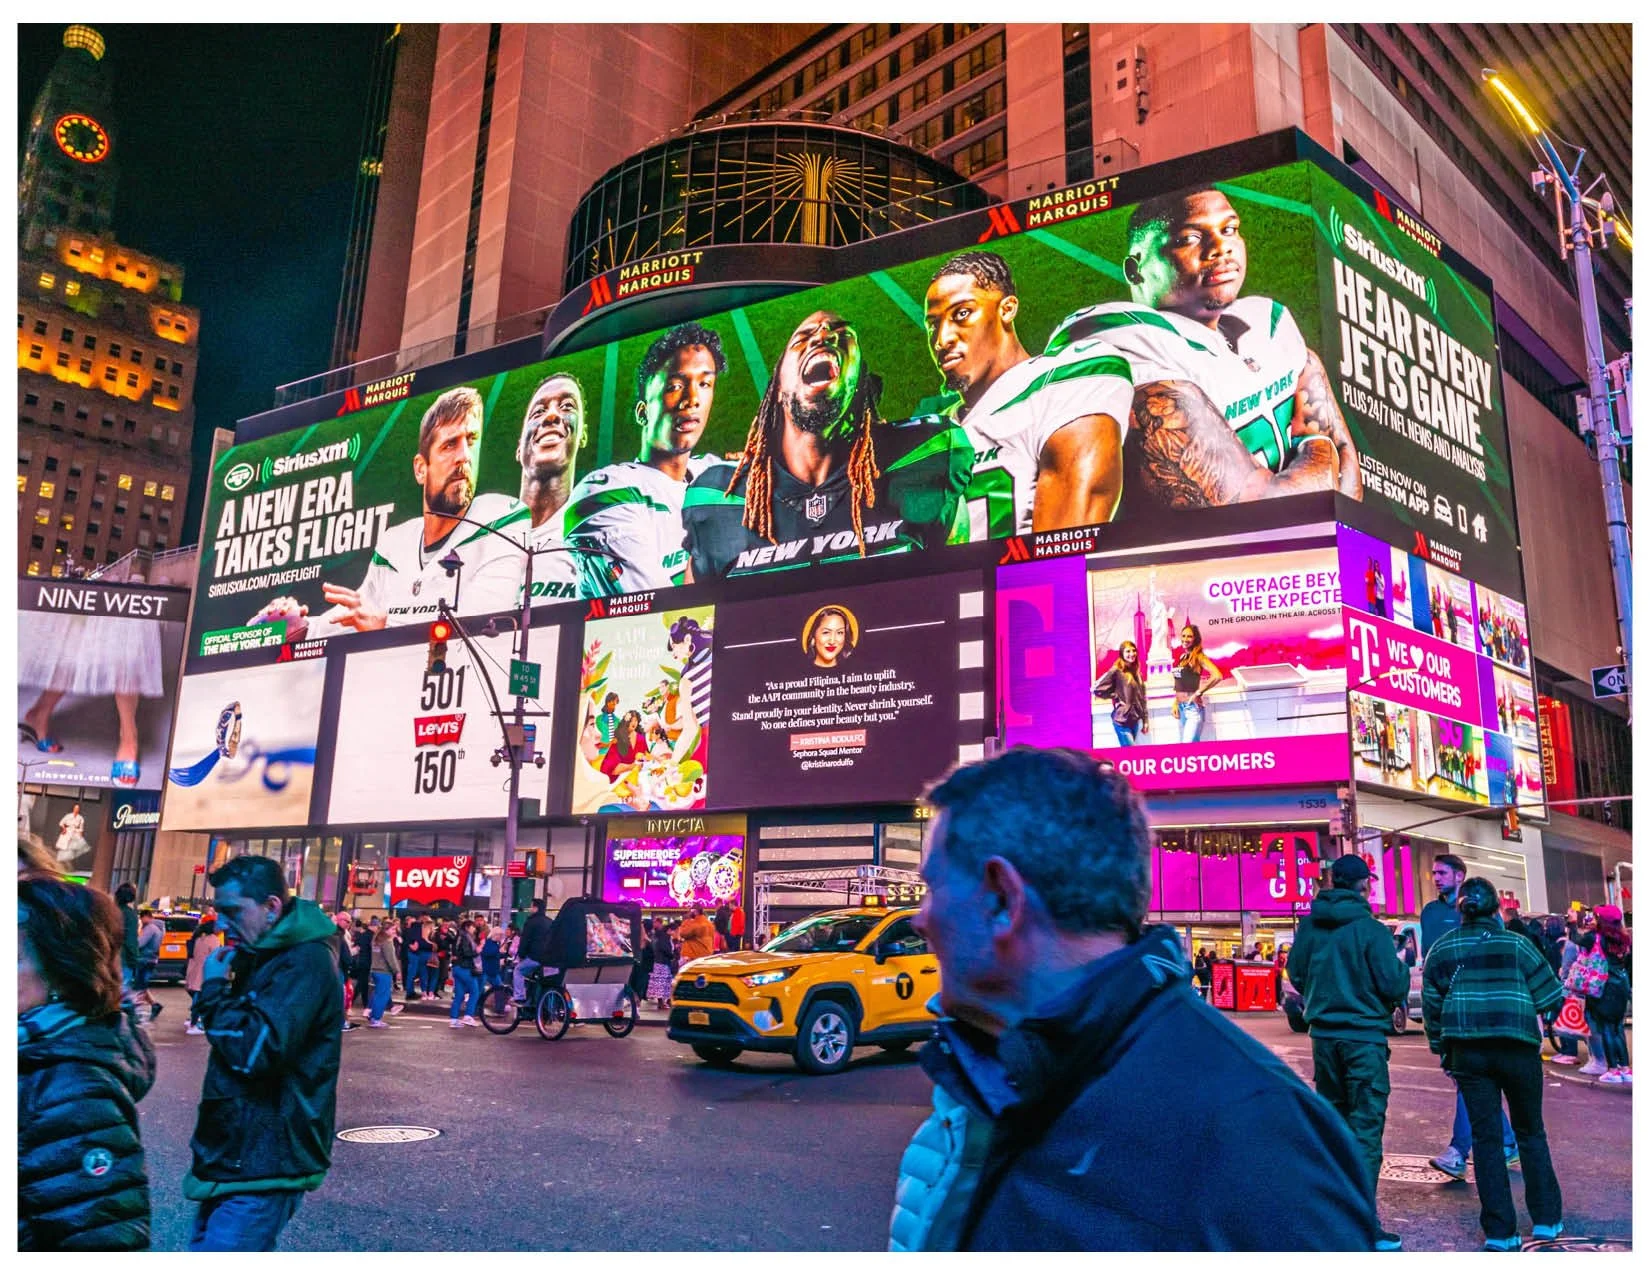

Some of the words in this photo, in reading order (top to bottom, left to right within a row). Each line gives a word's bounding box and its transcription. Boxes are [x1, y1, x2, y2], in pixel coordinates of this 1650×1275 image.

[1029, 177, 1120, 211] MARRIOTT
[1029, 195, 1109, 227] MARQUIS
[1396, 208, 1441, 251] MARRIOTT
[620, 251, 703, 281] MARRIOTT
[618, 269, 690, 296] MARQUIS
[1333, 257, 1415, 361] HEAR
[1415, 314, 1492, 411] EVERY
[364, 385, 408, 406] MARQUIS
[366, 372, 416, 394] MARRIOTT
[1224, 391, 1262, 421] NEW
[1265, 369, 1294, 400] YORK
[1340, 319, 1408, 410] JETS
[1410, 365, 1484, 457] GAME
[1343, 381, 1366, 414] PLUS
[1367, 395, 1390, 426] 24/7
[1389, 408, 1409, 437] NFL
[1408, 418, 1433, 453] NEWS
[1433, 433, 1451, 461] AND
[1451, 446, 1486, 482] ANALYSIS
[1358, 452, 1389, 478] LISTEN
[1389, 466, 1413, 490] NOW
[1413, 479, 1427, 498] ON
[216, 499, 236, 540] A
[240, 483, 299, 534] NEW
[300, 471, 353, 521] ERA
[1360, 470, 1382, 494] THE
[1383, 480, 1408, 505] SXM
[1408, 494, 1430, 516] APP
[214, 524, 293, 578] TAKES
[294, 503, 395, 563] FLIGHT
[736, 538, 808, 569] NEW
[811, 520, 903, 555] YORK
[1036, 527, 1100, 545] MARRIOTT
[1036, 540, 1093, 556] MARQUIS
[1430, 540, 1462, 562] MARRIOTT
[1430, 552, 1461, 572] MARQUIS
[208, 565, 322, 599] SIRIUSXM.COM/TAKEFLIGHT
[1209, 575, 1301, 598] COVERAGE
[37, 587, 97, 611] NINE
[104, 592, 168, 616] WEST
[609, 603, 649, 616] MARQUIS
[610, 592, 656, 606] MARRIOTT
[1230, 596, 1262, 613] THE
[1268, 588, 1342, 609] EXPECTE
[1236, 615, 1267, 623] GROUND.
[1308, 609, 1336, 617] ACROSS
[203, 645, 220, 656] THE
[220, 641, 239, 653] NEW
[240, 639, 262, 650] YORK
[262, 634, 282, 647] JETS
[204, 634, 231, 645] OFFICIAL
[231, 629, 261, 642] SPONSOR
[262, 627, 273, 637] OF
[295, 639, 328, 650] MARRIOTT
[294, 648, 323, 659] MARQUIS
[1386, 637, 1409, 665] WE
[1425, 652, 1452, 680] OUR
[420, 665, 466, 711] 501
[520, 674, 528, 682] 45
[784, 677, 808, 692] proud
[846, 673, 863, 684] aim
[863, 672, 872, 682] to
[873, 669, 896, 684] uplift
[1388, 665, 1462, 708] CUSTOMERS
[748, 693, 761, 704] the
[761, 693, 781, 703] AAPI
[781, 688, 826, 702] community
[826, 688, 835, 697] in
[835, 686, 849, 696] the
[850, 683, 878, 698] beauty
[878, 679, 915, 693] industry.
[731, 710, 754, 721] Stand
[754, 707, 784, 722] proudly
[784, 707, 793, 717] in
[793, 707, 811, 718] your
[844, 701, 867, 712] Never
[868, 697, 896, 710] shrink
[896, 694, 933, 709] yourself.
[760, 720, 773, 731] No
[773, 721, 787, 730] one
[787, 717, 816, 729] defines
[816, 716, 835, 728] your
[835, 713, 863, 726] beauty
[863, 712, 877, 722] but
[792, 749, 818, 760] Sephora
[818, 748, 838, 759] Squad
[838, 746, 863, 756] Mentor
[801, 758, 854, 770] @kristinarodulfo
[1119, 759, 1157, 776] OUR
[1161, 751, 1276, 774] CUSTOMERS
[1299, 799, 1327, 809] 1535
[647, 818, 705, 833] INVICTA
[613, 848, 681, 861] SUPERHEROES
